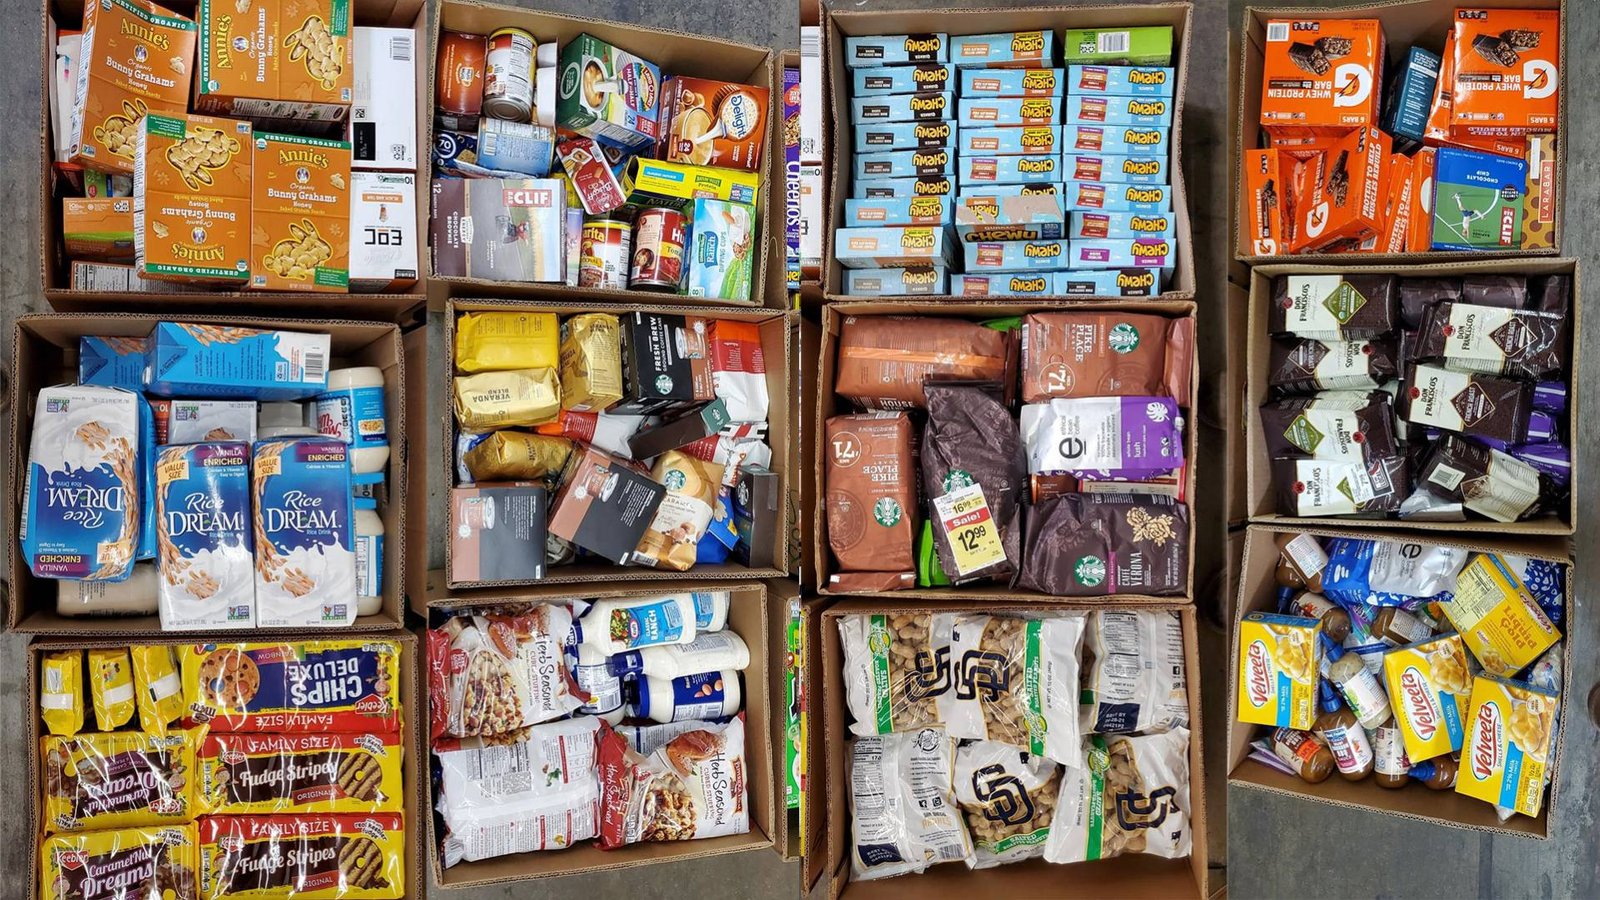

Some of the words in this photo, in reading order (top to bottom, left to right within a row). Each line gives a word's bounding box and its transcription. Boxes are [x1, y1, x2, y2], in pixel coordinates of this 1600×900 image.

[150, 16, 186, 29] ORGANIC
[257, 8, 265, 50] Grahams
[120, 18, 170, 51] Annie's
[213, 14, 232, 69] Annie's
[106, 56, 134, 76] Bunny
[134, 70, 175, 88] Grahams
[257, 52, 266, 82] Bunny
[129, 78, 148, 91] Honey
[1314, 80, 1331, 89] BAR
[1333, 63, 1373, 108] G
[1457, 82, 1495, 91] PROTEIN
[1497, 82, 1521, 91] WHEY
[1503, 75, 1521, 83] BAR
[1523, 60, 1559, 99] G
[1268, 89, 1304, 98] PROTEIN
[1306, 89, 1332, 99] WHEY
[627, 115, 635, 125] 24
[731, 95, 748, 138] Delight
[265, 135, 304, 144] CERTIFIED
[306, 139, 342, 148] ORGANIC
[439, 140, 451, 150] 70
[1496, 144, 1514, 154] BARS
[279, 149, 329, 170] Annie's
[1517, 163, 1523, 171] 6
[1368, 182, 1378, 221] MUSCLES
[1373, 144, 1382, 181] REBUILD
[1466, 175, 1499, 183] CHOCOLATE
[267, 188, 297, 201] Bunny
[298, 192, 337, 204] Grahams
[433, 183, 441, 194] 12
[1541, 165, 1552, 219] LARABAR
[189, 200, 209, 208] Honey
[293, 201, 312, 210] Honey
[514, 192, 549, 205] CLIF
[1363, 178, 1372, 217] PROTEIN
[161, 207, 203, 219] Grahams
[204, 208, 236, 221] Bunny
[1306, 202, 1329, 239] G
[364, 228, 402, 246] EOC
[1501, 216, 1513, 244] CLIF
[172, 243, 225, 263] Annie's
[706, 235, 717, 263] Ranch
[157, 264, 195, 273] ORGANIC
[199, 266, 239, 276] CERTIFIED
[650, 317, 659, 345] BREW
[1085, 325, 1093, 352] PIKE
[1076, 325, 1085, 362] PLACE
[653, 349, 662, 371] FRESH
[472, 392, 511, 403] VERANDA
[1343, 428, 1351, 444] DON
[214, 449, 243, 457] VANILLA
[308, 454, 346, 462] ENRICHED
[163, 462, 185, 473] VALUE
[203, 457, 243, 466] ENRICHED
[258, 458, 278, 468] VALUE
[168, 471, 182, 480] SIZE
[261, 466, 274, 474] SIZE
[863, 466, 898, 474] PLACE
[872, 474, 898, 482] PIKE
[48, 486, 123, 512] DREAM
[184, 492, 224, 513] Rice
[283, 490, 323, 511] Rice
[64, 509, 104, 529] Rice
[266, 507, 338, 533] DREAM
[953, 512, 981, 527] Sale!
[39, 554, 81, 563] ENRICHED
[1130, 551, 1144, 586] VERONA
[649, 608, 657, 642] RANCH
[1503, 607, 1538, 650] Liquid
[1500, 619, 1524, 651] Gold
[536, 629, 551, 662] Herb
[256, 650, 297, 662] RAINBOW
[288, 656, 360, 674] DELUXE
[1249, 640, 1268, 704] Velveeta
[291, 675, 363, 707] CHIPS
[537, 662, 556, 713] Seasoned
[356, 697, 391, 713] Keebler
[1402, 673, 1436, 735] Velveeta
[255, 713, 284, 726] SIZE
[286, 713, 334, 726] FAMILY
[252, 738, 297, 751] FAMILY
[299, 737, 330, 750] SIZE
[1476, 703, 1497, 777] Velveeta
[219, 751, 246, 762] Keebler
[710, 752, 725, 779] Herb
[239, 768, 285, 788] Fudge
[296, 789, 332, 801] ORIGINAL
[712, 779, 725, 827] Seasoned
[251, 821, 297, 836] FAMILY
[299, 819, 330, 833] SIZE
[56, 850, 90, 865] Keebler
[239, 853, 285, 874] Fudge
[286, 846, 336, 865] Stripes
[90, 856, 132, 877] Caramel
[80, 864, 155, 895] Dreams
